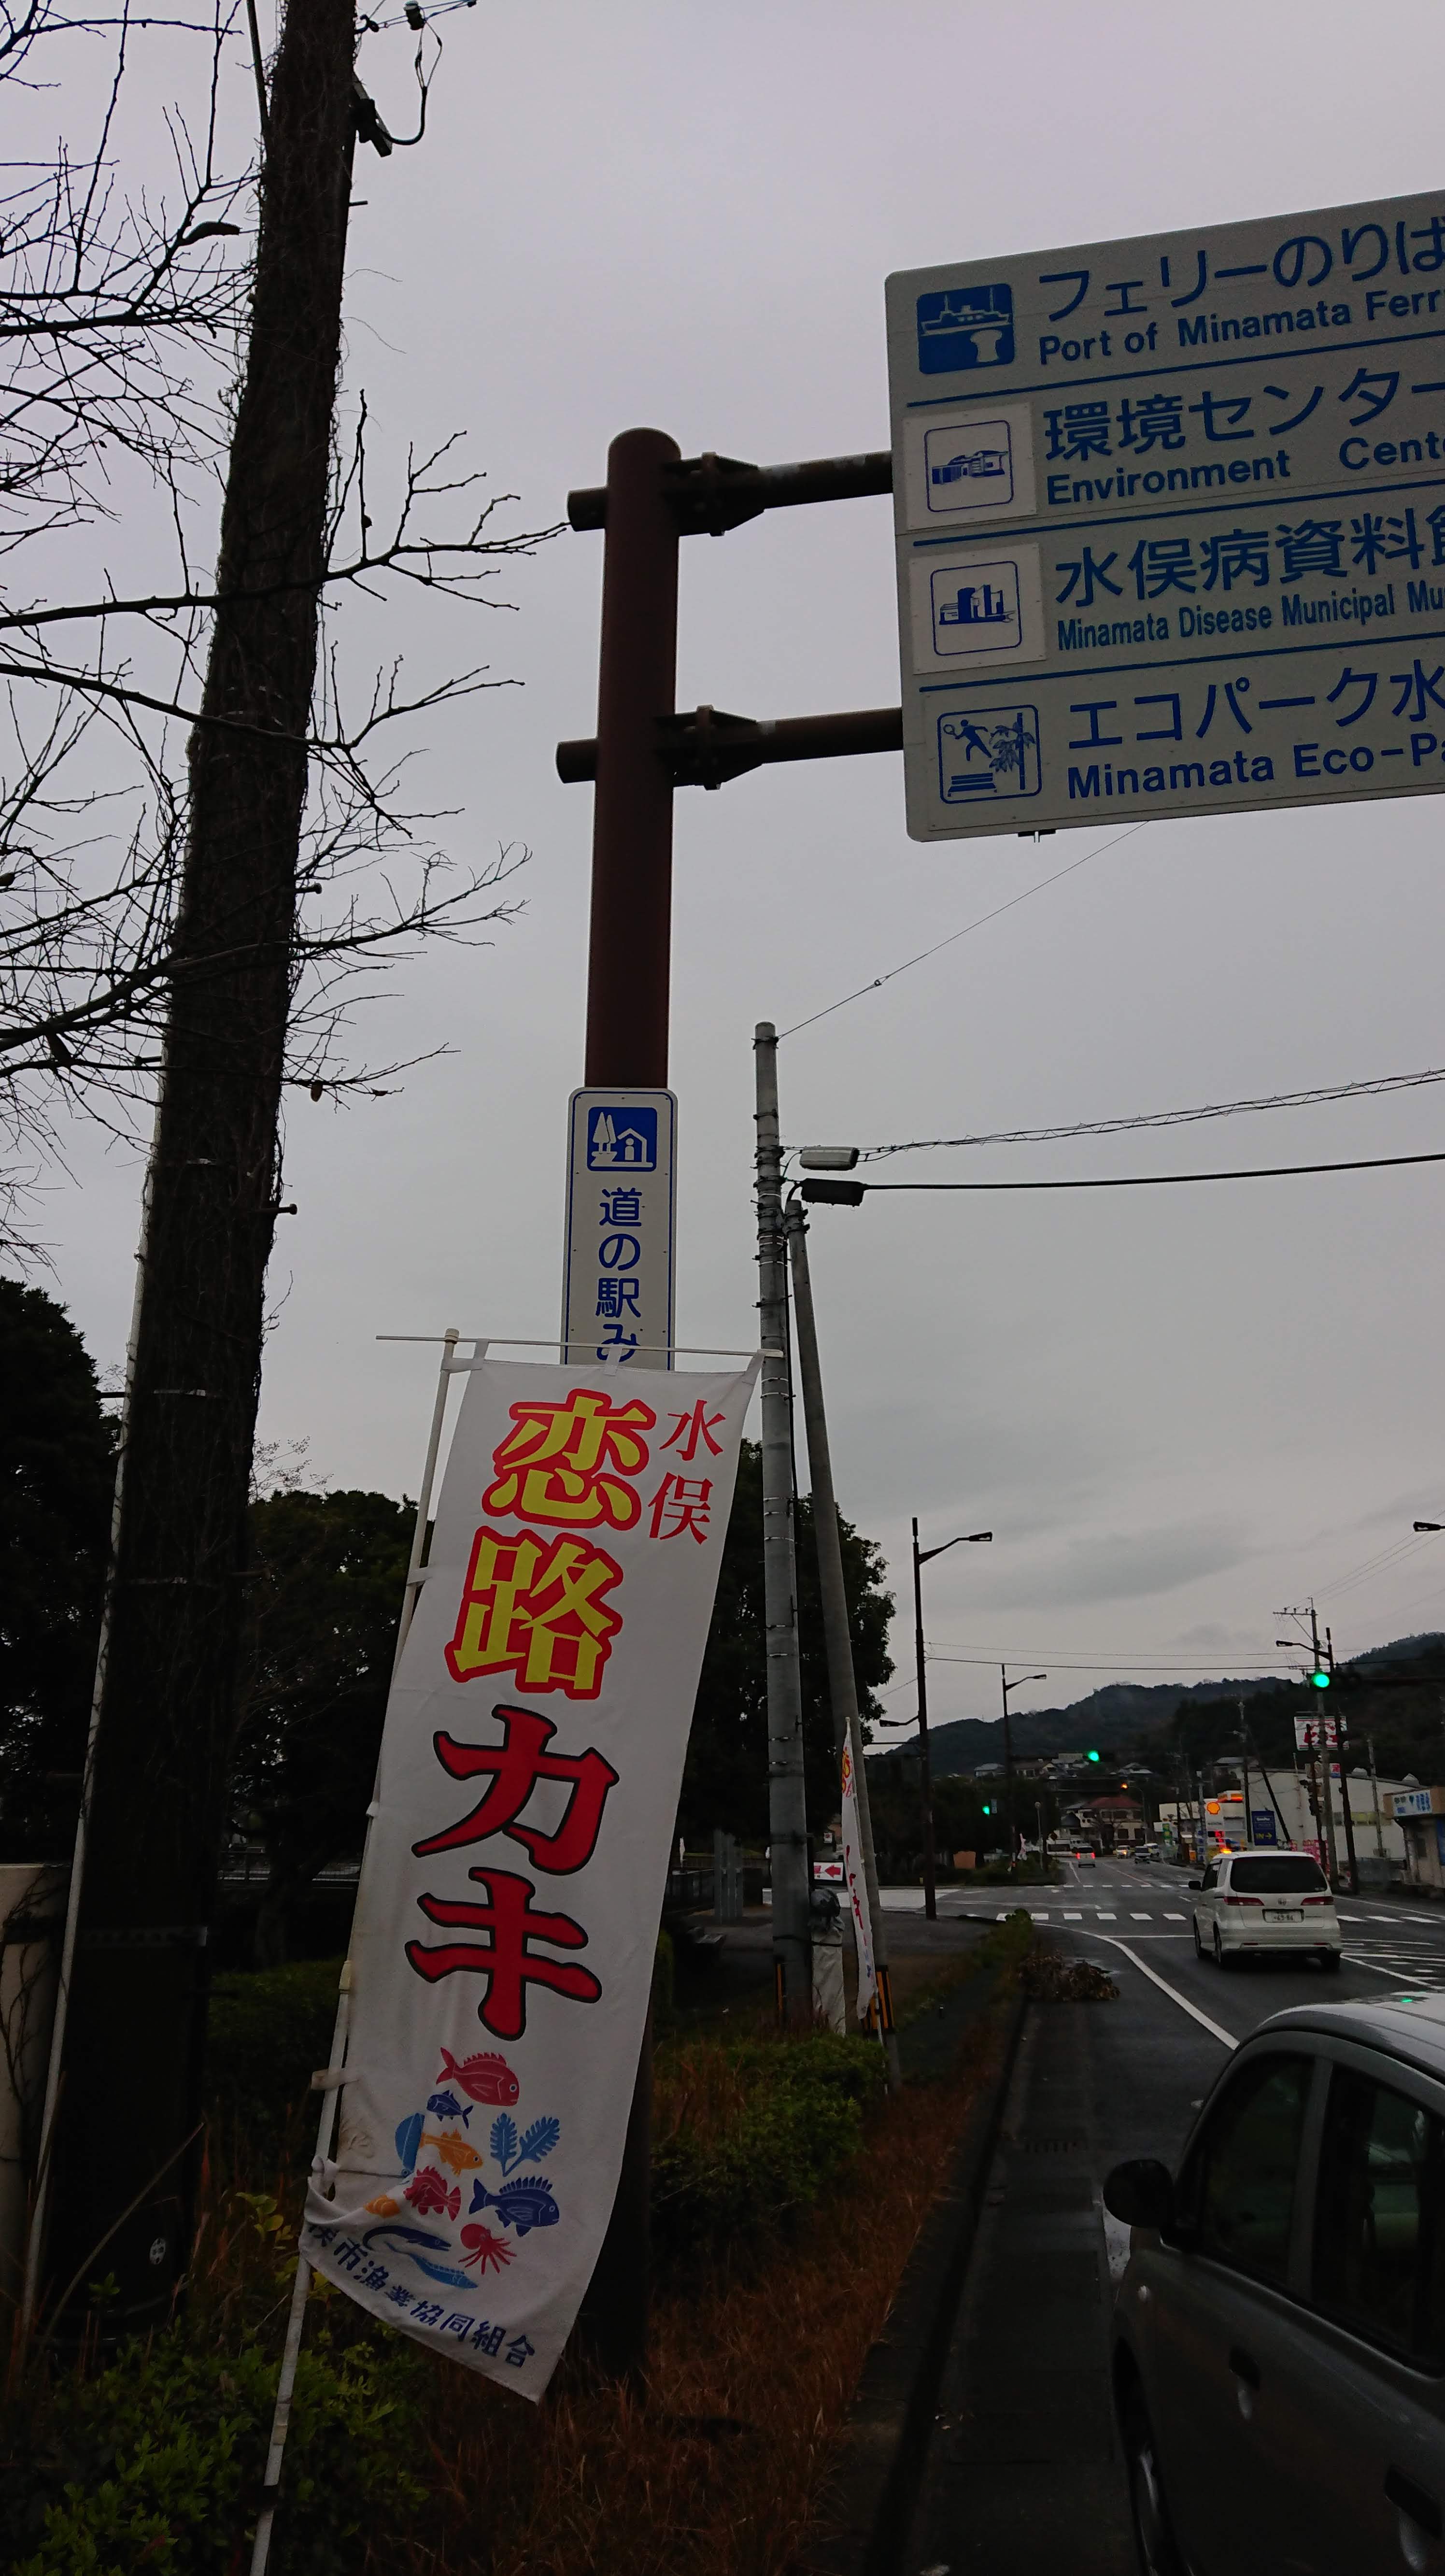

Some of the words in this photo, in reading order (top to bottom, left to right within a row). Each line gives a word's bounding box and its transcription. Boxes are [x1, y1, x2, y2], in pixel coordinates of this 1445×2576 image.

[1039, 216, 1445, 322] フェリーのりば
[1039, 329, 1111, 365] Port
[1124, 322, 1158, 353] of
[1177, 299, 1351, 347] Minamata
[1366, 289, 1445, 321] Ferr
[1043, 368, 1445, 461] 環境センター
[1048, 450, 1291, 505] Environment
[1339, 431, 1445, 470] Cent
[1058, 613, 1169, 652] Minamata
[1180, 605, 1272, 638] Disease
[1281, 583, 1395, 627] Municipal
[1406, 579, 1445, 612] Mu
[1068, 659, 1445, 750] エコパーク水
[1068, 750, 1274, 799] Minamata
[1294, 732, 1445, 777] Eco-P
[595, 1187, 642, 1363] 道の駅み
[648, 1399, 726, 1545] 水俣
[404, 1388, 657, 2041] 恋路カキ
